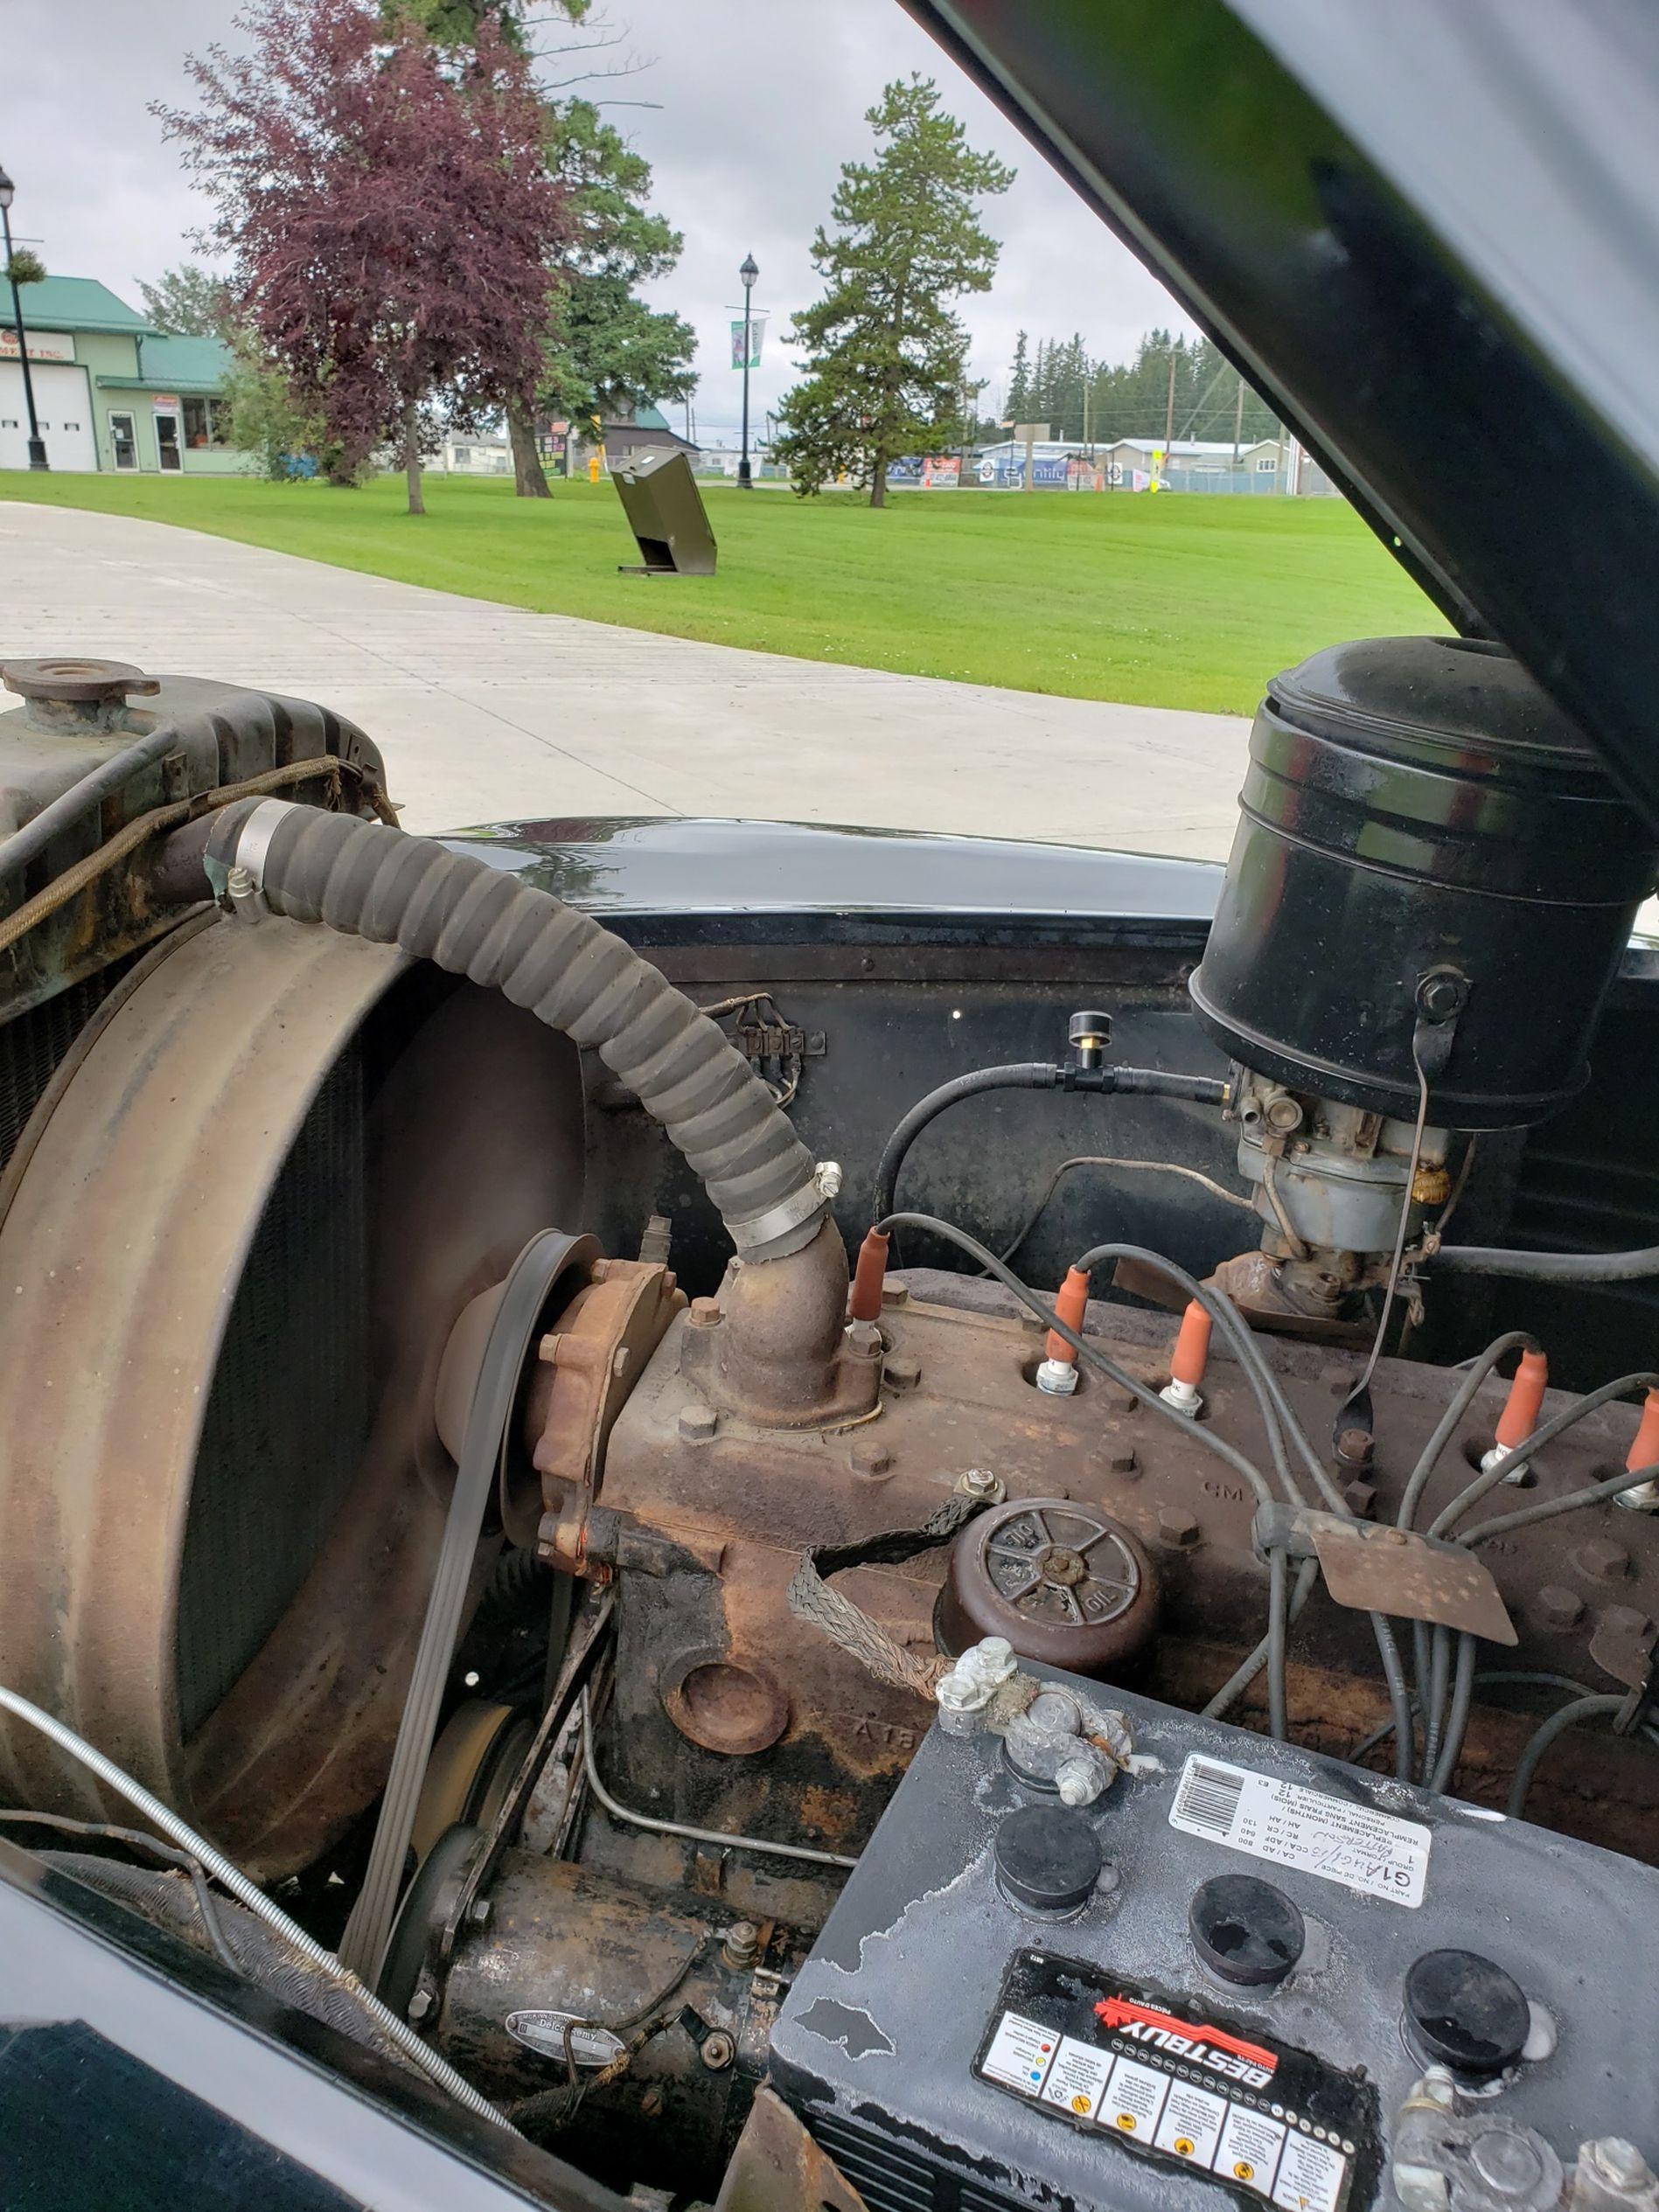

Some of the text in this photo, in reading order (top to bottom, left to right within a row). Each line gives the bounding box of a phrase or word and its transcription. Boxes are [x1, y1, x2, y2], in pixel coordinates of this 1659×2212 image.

[1085, 1589, 1118, 1613] OIL
[1279, 1781, 1293, 1791] 12
[1278, 1788, 1292, 1798] 12
[1296, 1793, 1341, 1812] PARTICULIER
[1268, 1814, 1281, 1824] AH
[1270, 1792, 1419, 1846] REMPLACEMENT SANS FRAIS (MOIS)
[1286, 1805, 1328, 1825] (MONTHS)
[1347, 1810, 1384, 1826] PERSONAL
[1242, 1817, 1257, 1826] 130
[1287, 1820, 1300, 1829] AH
[1239, 1826, 1256, 1837] 640
[1266, 1824, 1279, 1833] CR
[1329, 1820, 1393, 1846] REPLACEMENT
[1286, 1830, 1299, 1840] RC
[1237, 1836, 1253, 1847] 800
[1288, 1841, 1308, 1854] CCA
[1262, 1844, 1275, 1854] AD
[1281, 1850, 1295, 1860] CA
[1351, 1847, 1381, 1861] FORMAT
[1387, 1858, 1413, 1872] GROUP
[1343, 1871, 1355, 1880] DE
[1382, 1866, 1412, 1889] G1
[1391, 1886, 1410, 1897] PART
[539, 2020, 566, 2033] Delco
[1119, 2021, 1272, 2090] BESTBUY
[1256, 2062, 1275, 2075] AUTO
